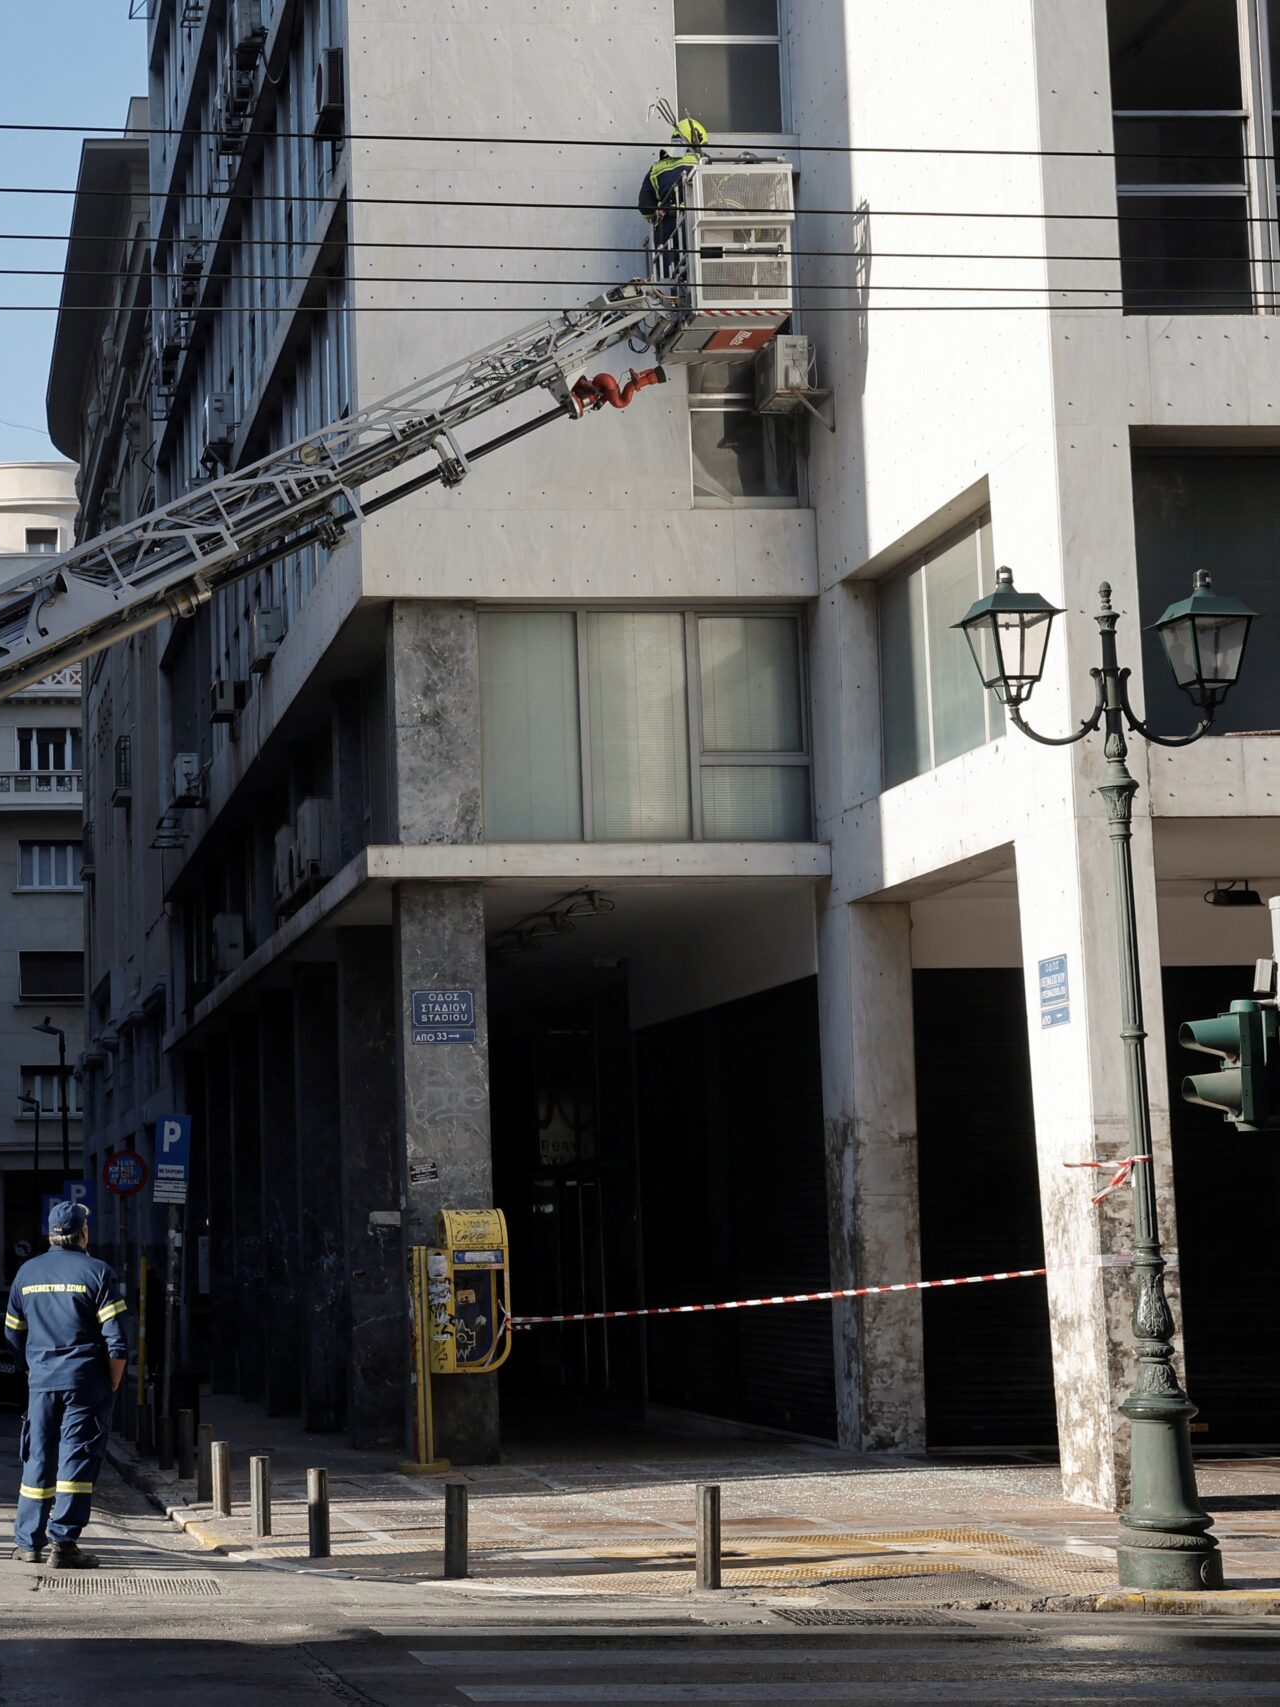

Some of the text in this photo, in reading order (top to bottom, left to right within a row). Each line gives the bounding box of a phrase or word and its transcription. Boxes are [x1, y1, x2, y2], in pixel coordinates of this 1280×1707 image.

[428, 993, 460, 1001] ΟΔΟΣ
[421, 1003, 467, 1012] ΣΤΑΔΙΟΥ
[421, 1014, 468, 1022] STADIOU
[415, 1032, 448, 1042] ΑΠΟ 33
[163, 1120, 182, 1153] P
[71, 1184, 87, 1205] P
